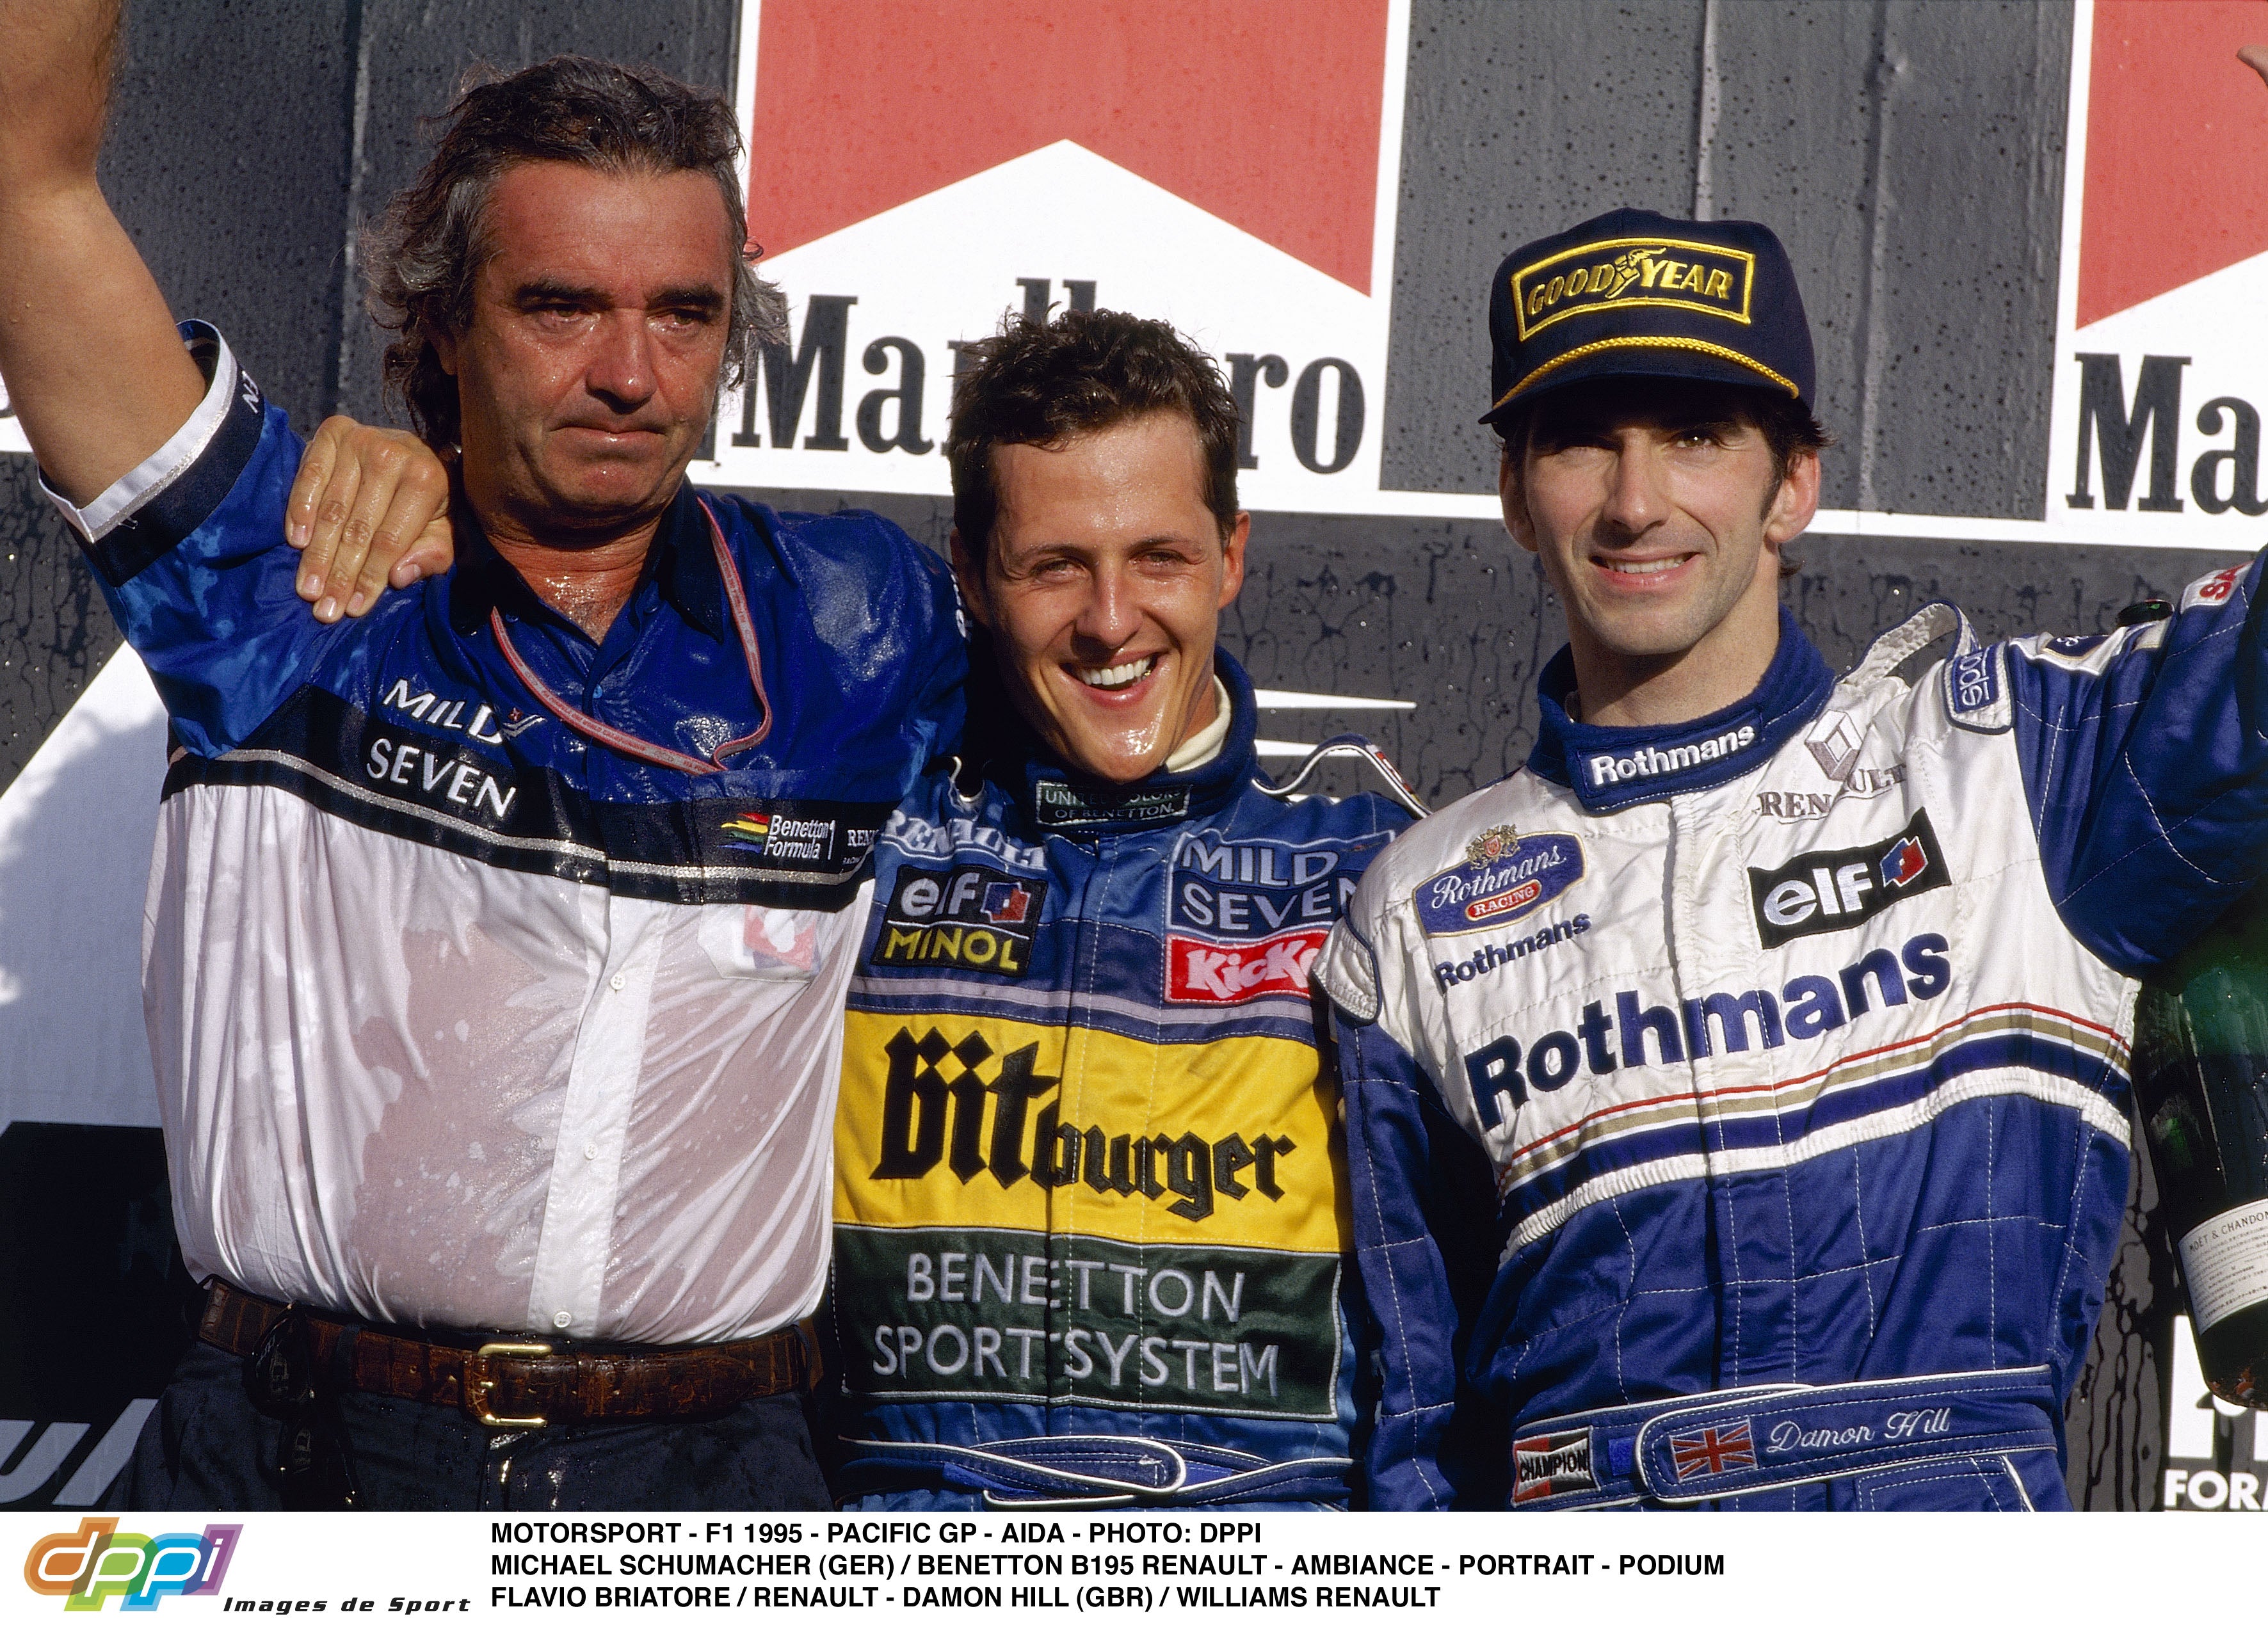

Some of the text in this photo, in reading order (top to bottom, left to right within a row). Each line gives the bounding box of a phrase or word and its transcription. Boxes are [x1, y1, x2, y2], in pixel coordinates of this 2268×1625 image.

[731, 278, 1365, 475] Maro
[383, 678, 503, 744] MILD
[367, 738, 516, 817] SEVEN
[1589, 724, 1755, 786] Rothmans
[1757, 763, 1906, 819] RENULT
[764, 835, 821, 859] Formula
[769, 815, 830, 839] Benetton
[1182, 838, 1339, 886] MILD
[1431, 845, 1566, 909] Rothmans
[901, 872, 980, 917] elf
[1474, 886, 1535, 917] RACING
[1764, 863, 1872, 926] elf
[884, 927, 1018, 971] MINOL
[1434, 913, 1592, 993] Rothmans
[1464, 933, 1951, 1132] Rothmans
[869, 1026, 1296, 1222] Bitburger
[906, 1253, 1245, 1323] BENETTON
[1768, 1407, 1950, 1454] Damon Hill
[1519, 1449, 1589, 1483] CHAMPION
